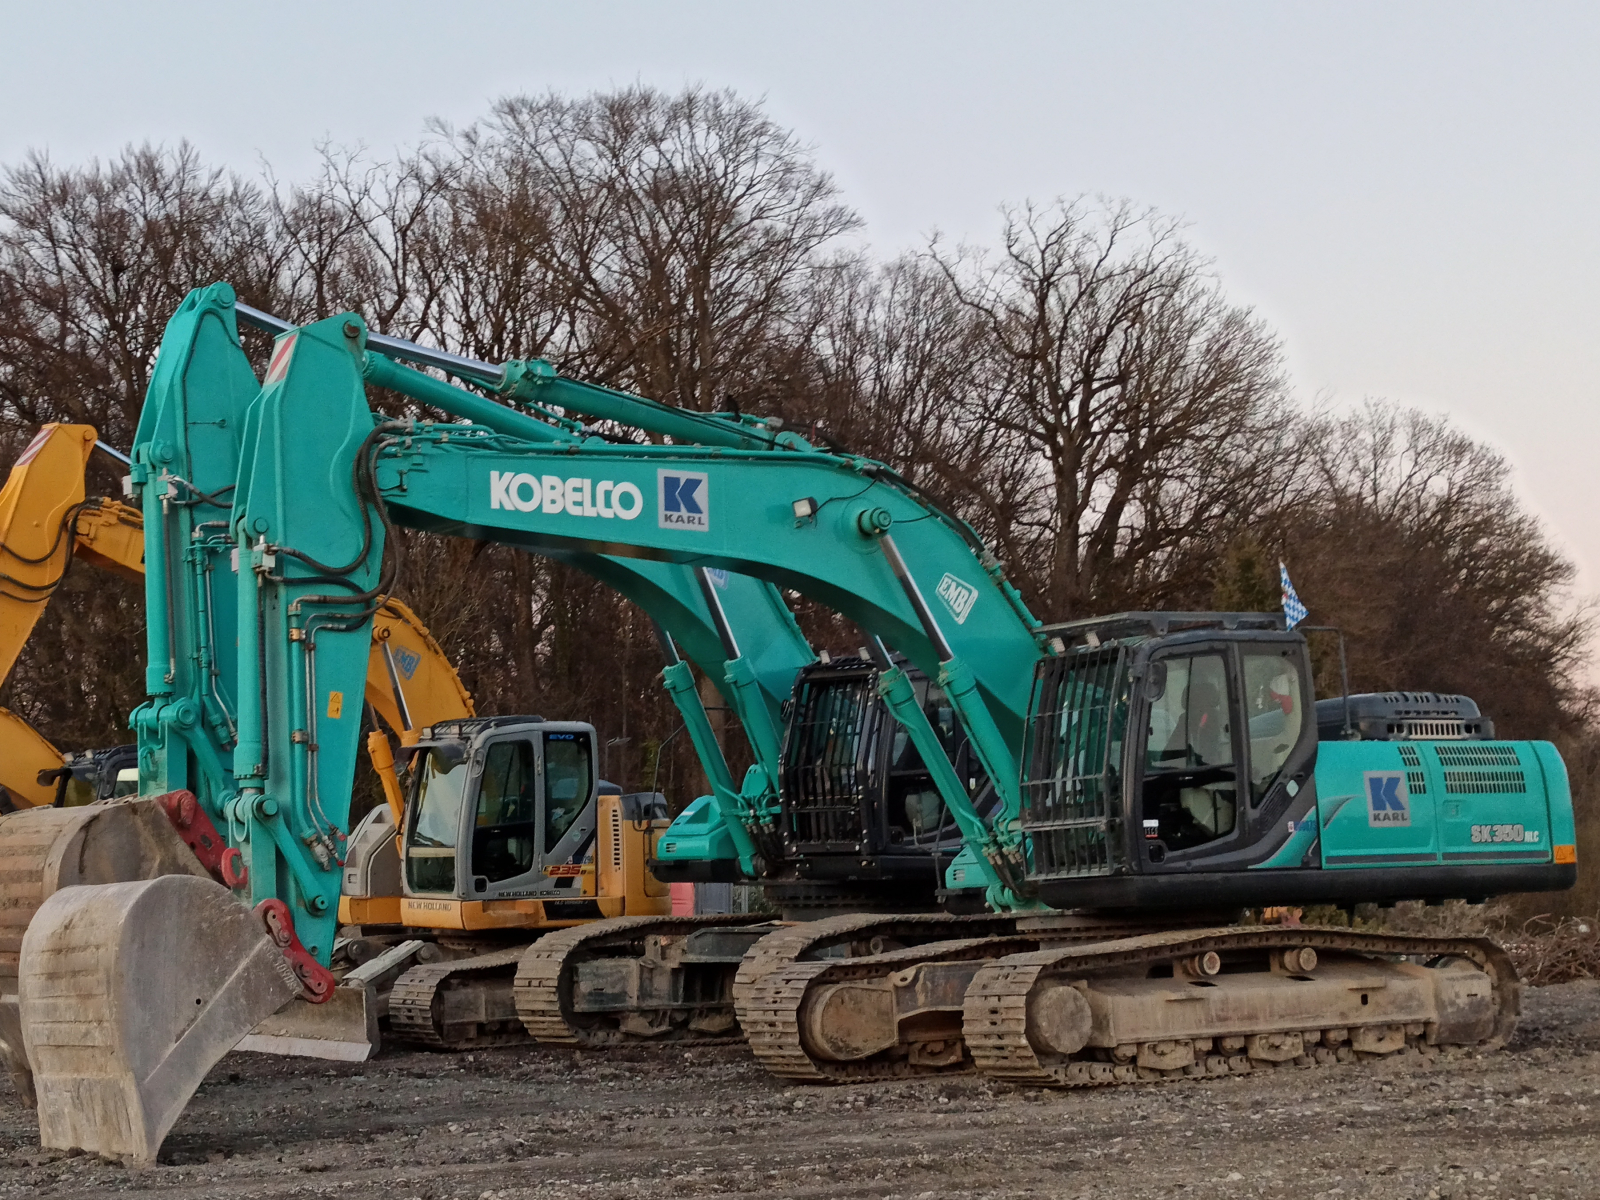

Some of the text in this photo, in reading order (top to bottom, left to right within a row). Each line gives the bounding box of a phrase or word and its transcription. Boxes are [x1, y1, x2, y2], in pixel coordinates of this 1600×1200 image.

[490, 470, 643, 520] KOBELCO
[664, 476, 704, 514] K
[664, 513, 705, 526] KARL
[938, 576, 970, 614] EMB
[1369, 777, 1405, 811] K
[1373, 812, 1408, 822] KARL
[408, 901, 452, 912] NEW HOLLAND
